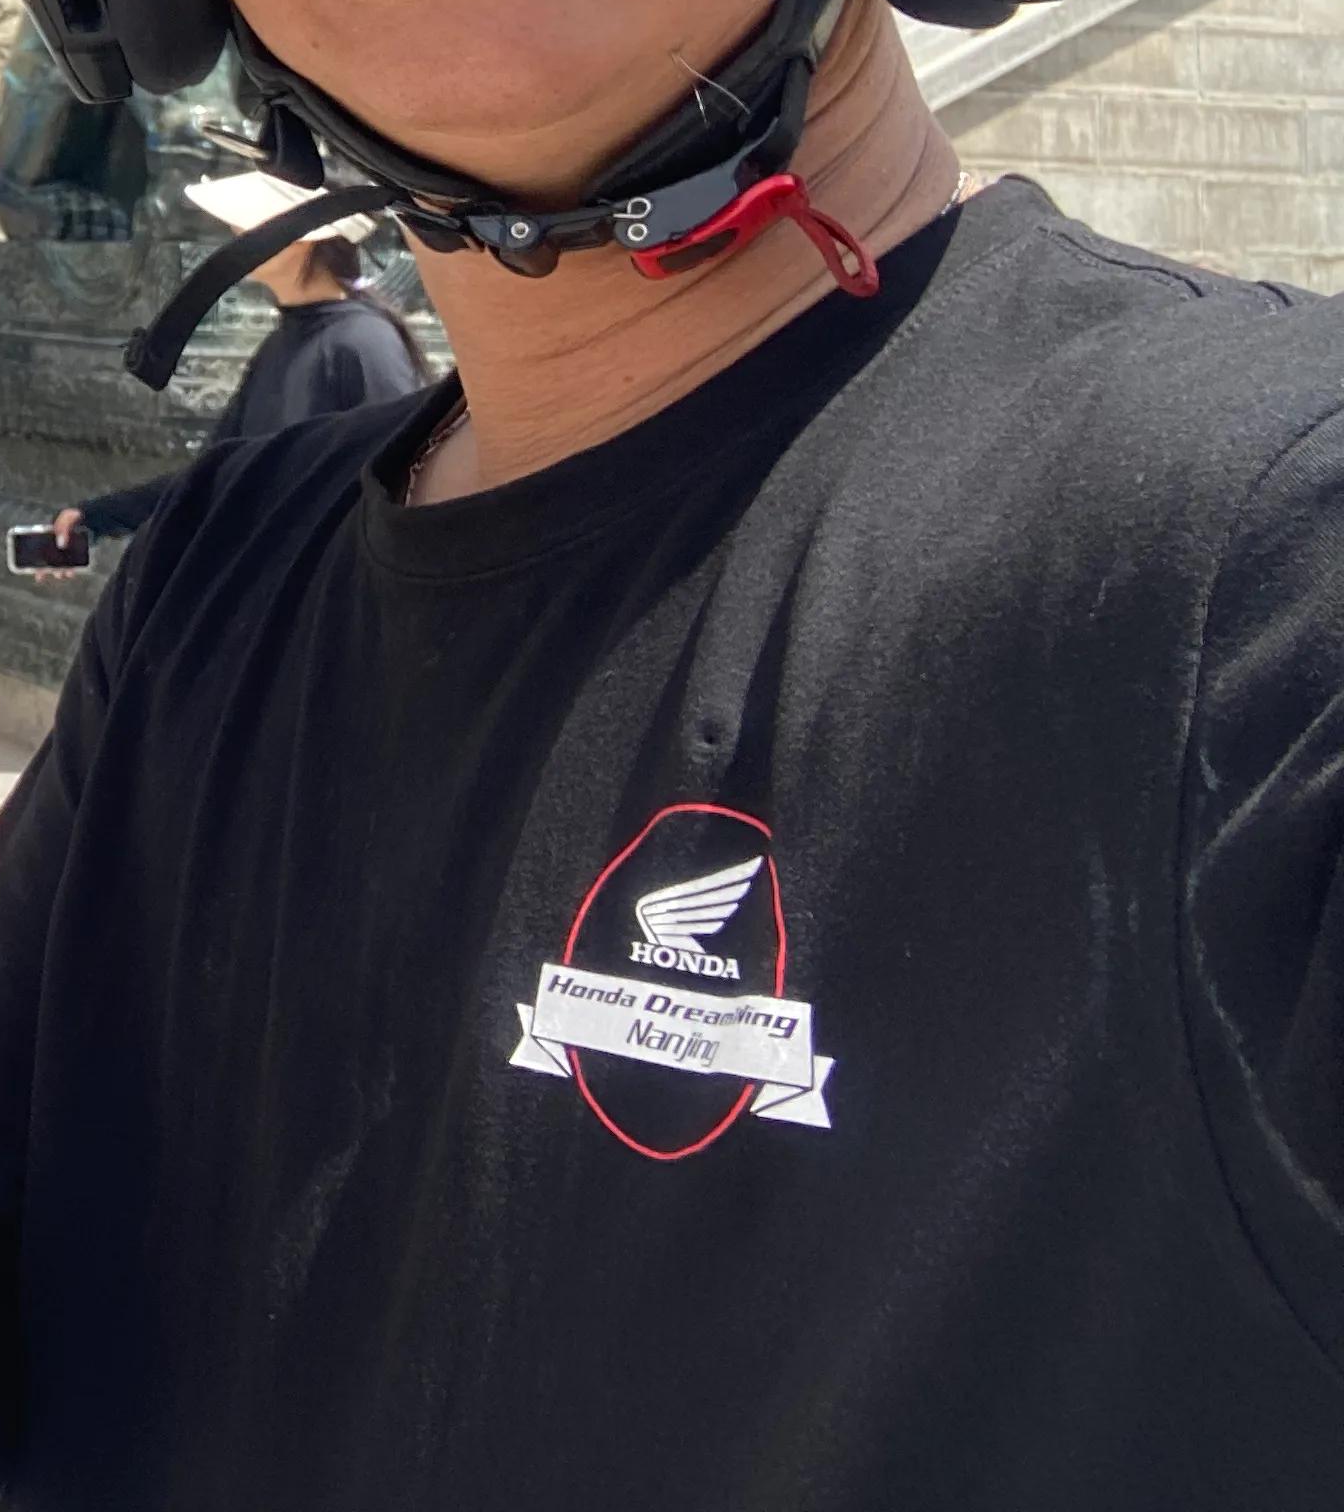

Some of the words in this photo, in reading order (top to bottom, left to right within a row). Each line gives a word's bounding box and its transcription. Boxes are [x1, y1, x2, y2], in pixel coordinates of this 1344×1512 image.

[628, 941, 741, 980] HONDA
[547, 974, 635, 1008] Honda
[625, 1019, 722, 1068] Nanjing
